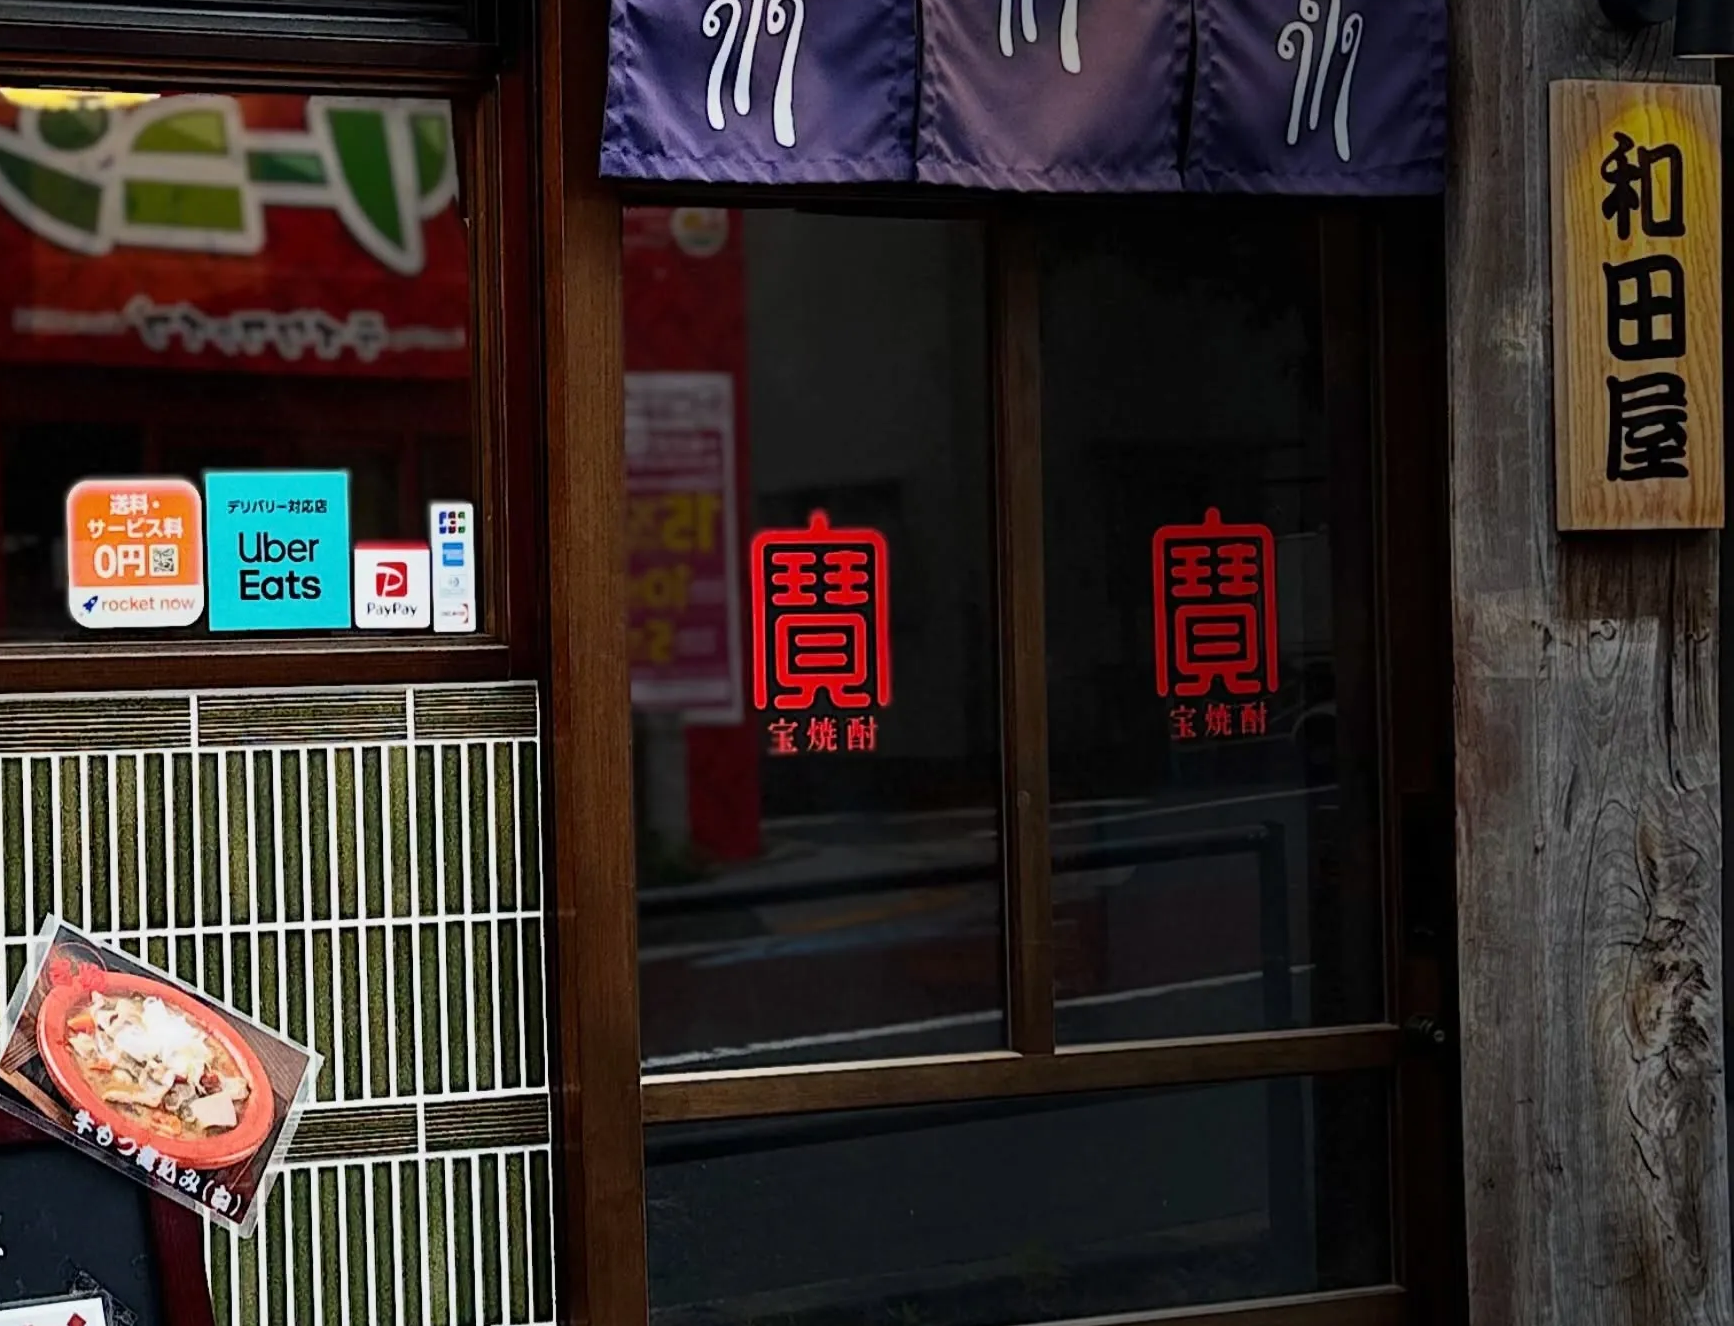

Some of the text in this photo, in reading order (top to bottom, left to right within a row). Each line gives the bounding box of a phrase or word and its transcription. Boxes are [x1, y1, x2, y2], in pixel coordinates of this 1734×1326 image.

[1601, 132, 1690, 482] 和田屋
[227, 499, 328, 515] デリバリー対応店
[86, 517, 184, 539] サービス料
[93, 545, 147, 579] 0円
[238, 532, 320, 564] Uber
[239, 569, 321, 602] Eats
[101, 596, 196, 613] rocket now
[367, 601, 418, 619] PayPay
[767, 716, 879, 754] 宝焼酎
[1168, 701, 1268, 741] 宝焼酎
